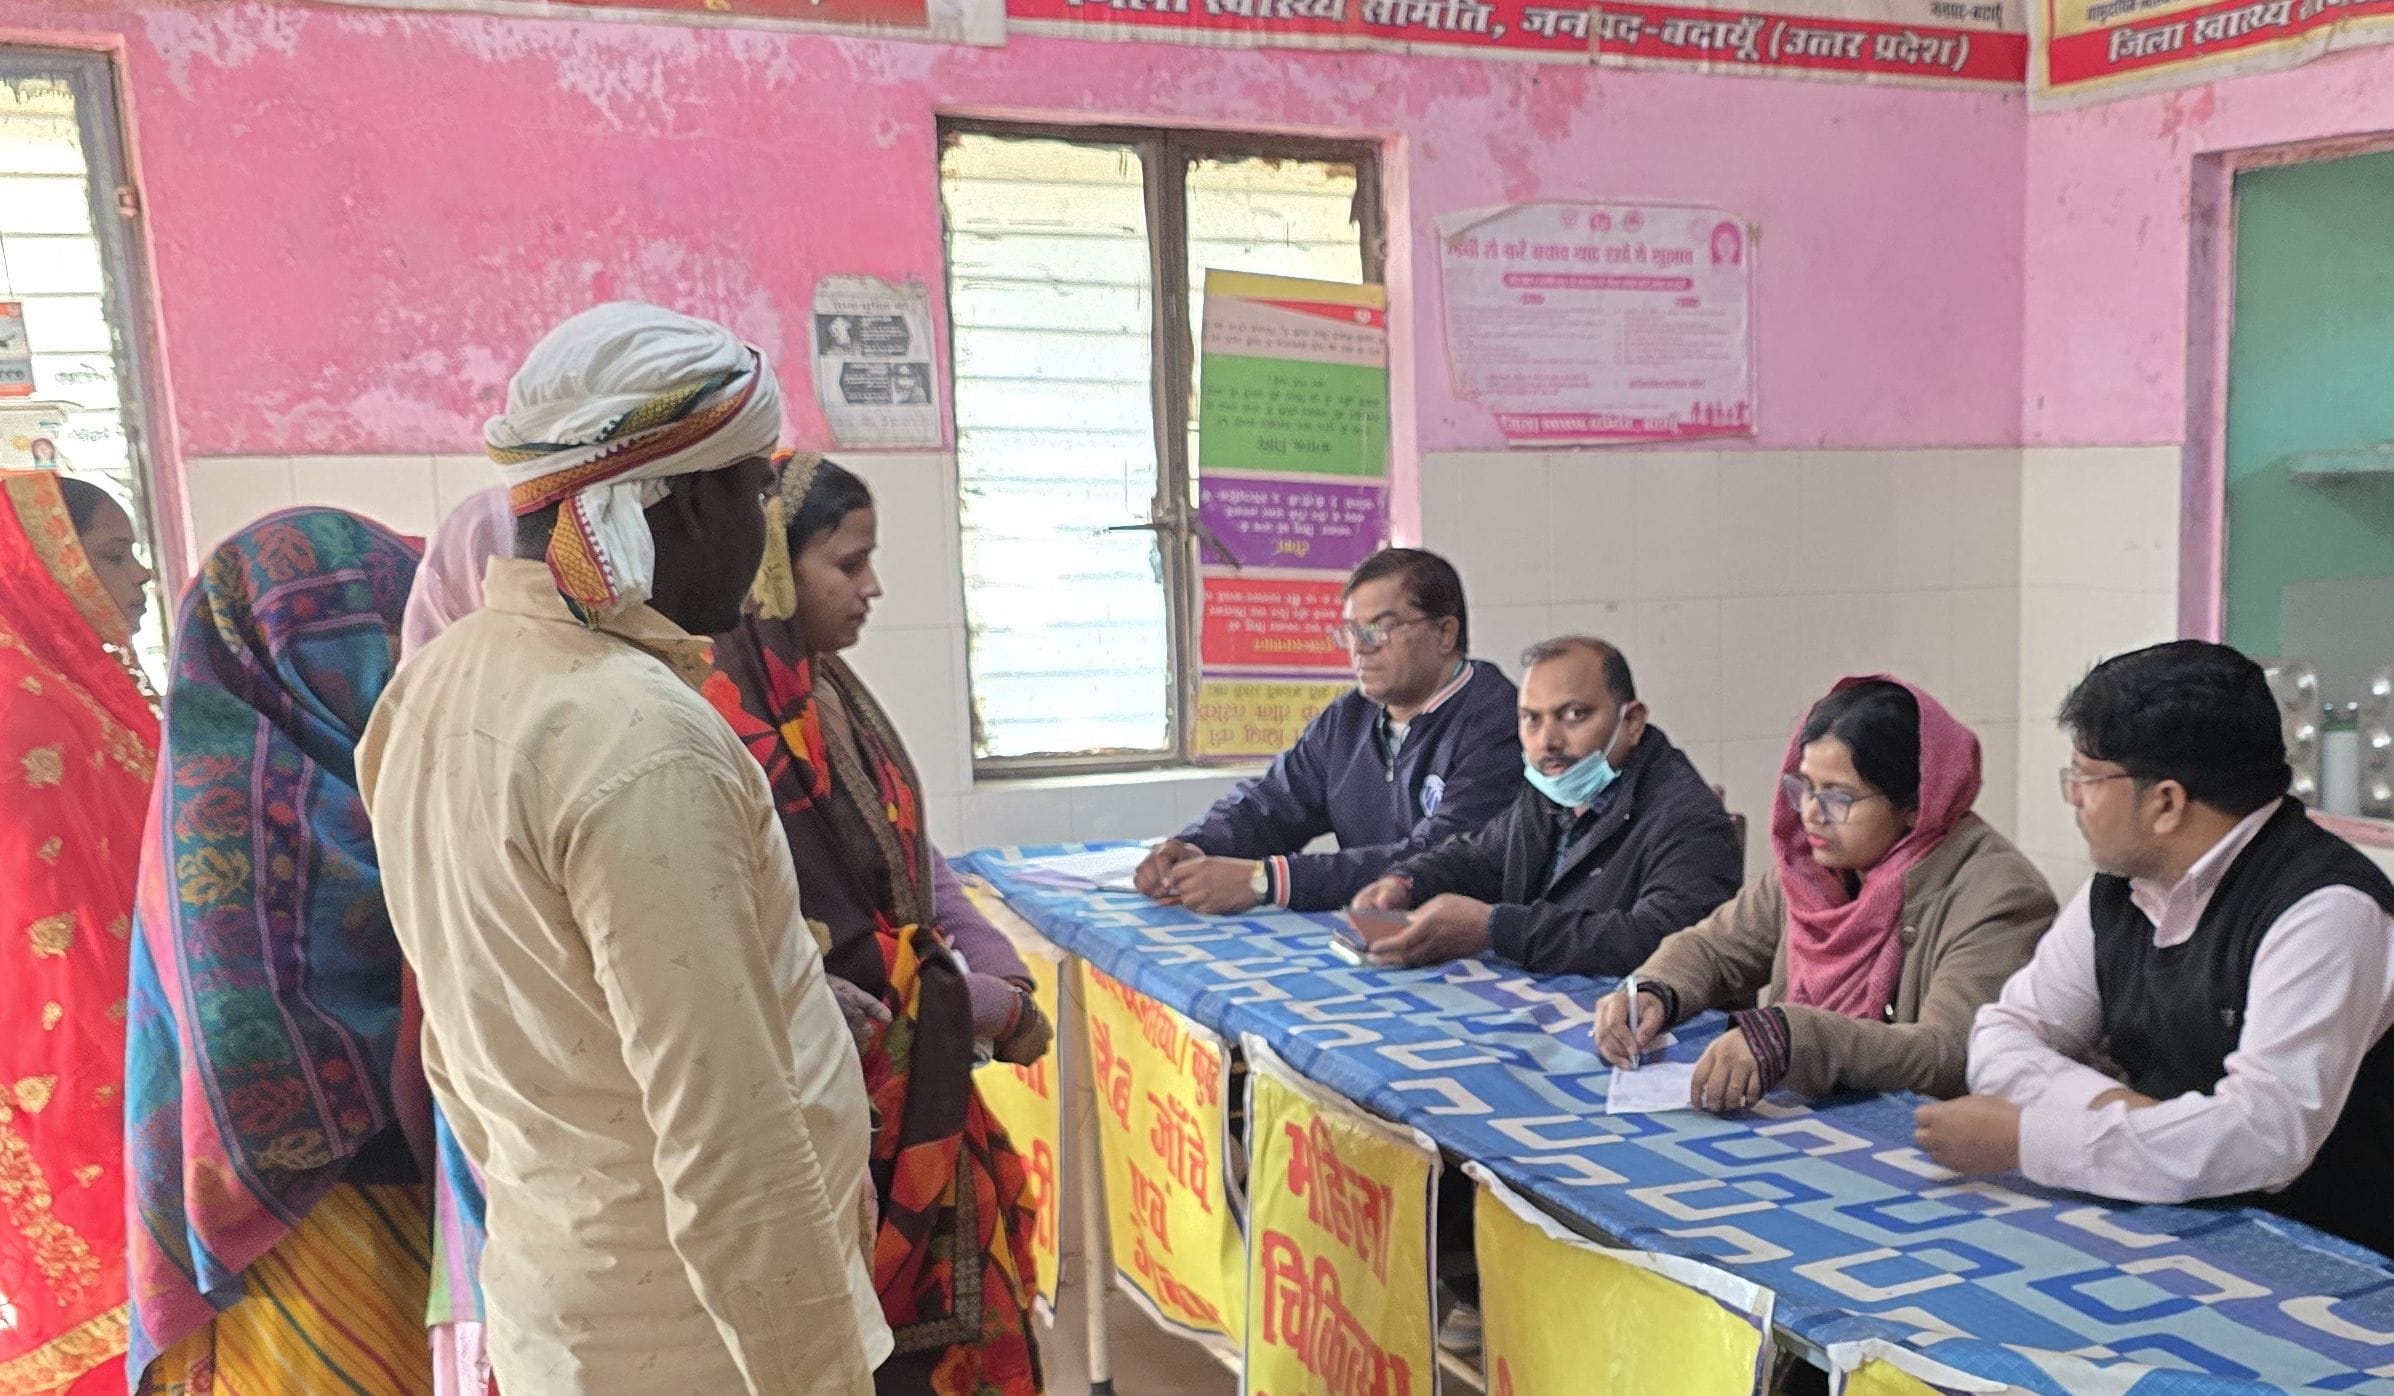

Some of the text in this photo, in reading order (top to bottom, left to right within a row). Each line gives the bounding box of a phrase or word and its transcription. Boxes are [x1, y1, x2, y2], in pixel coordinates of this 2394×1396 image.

[1769, 20, 1871, 58] (उत्तर
[1872, 32, 1970, 71] प्रदेश)
[2107, 20, 2191, 63] जिला
[1285, 1113, 1393, 1288] महिला
